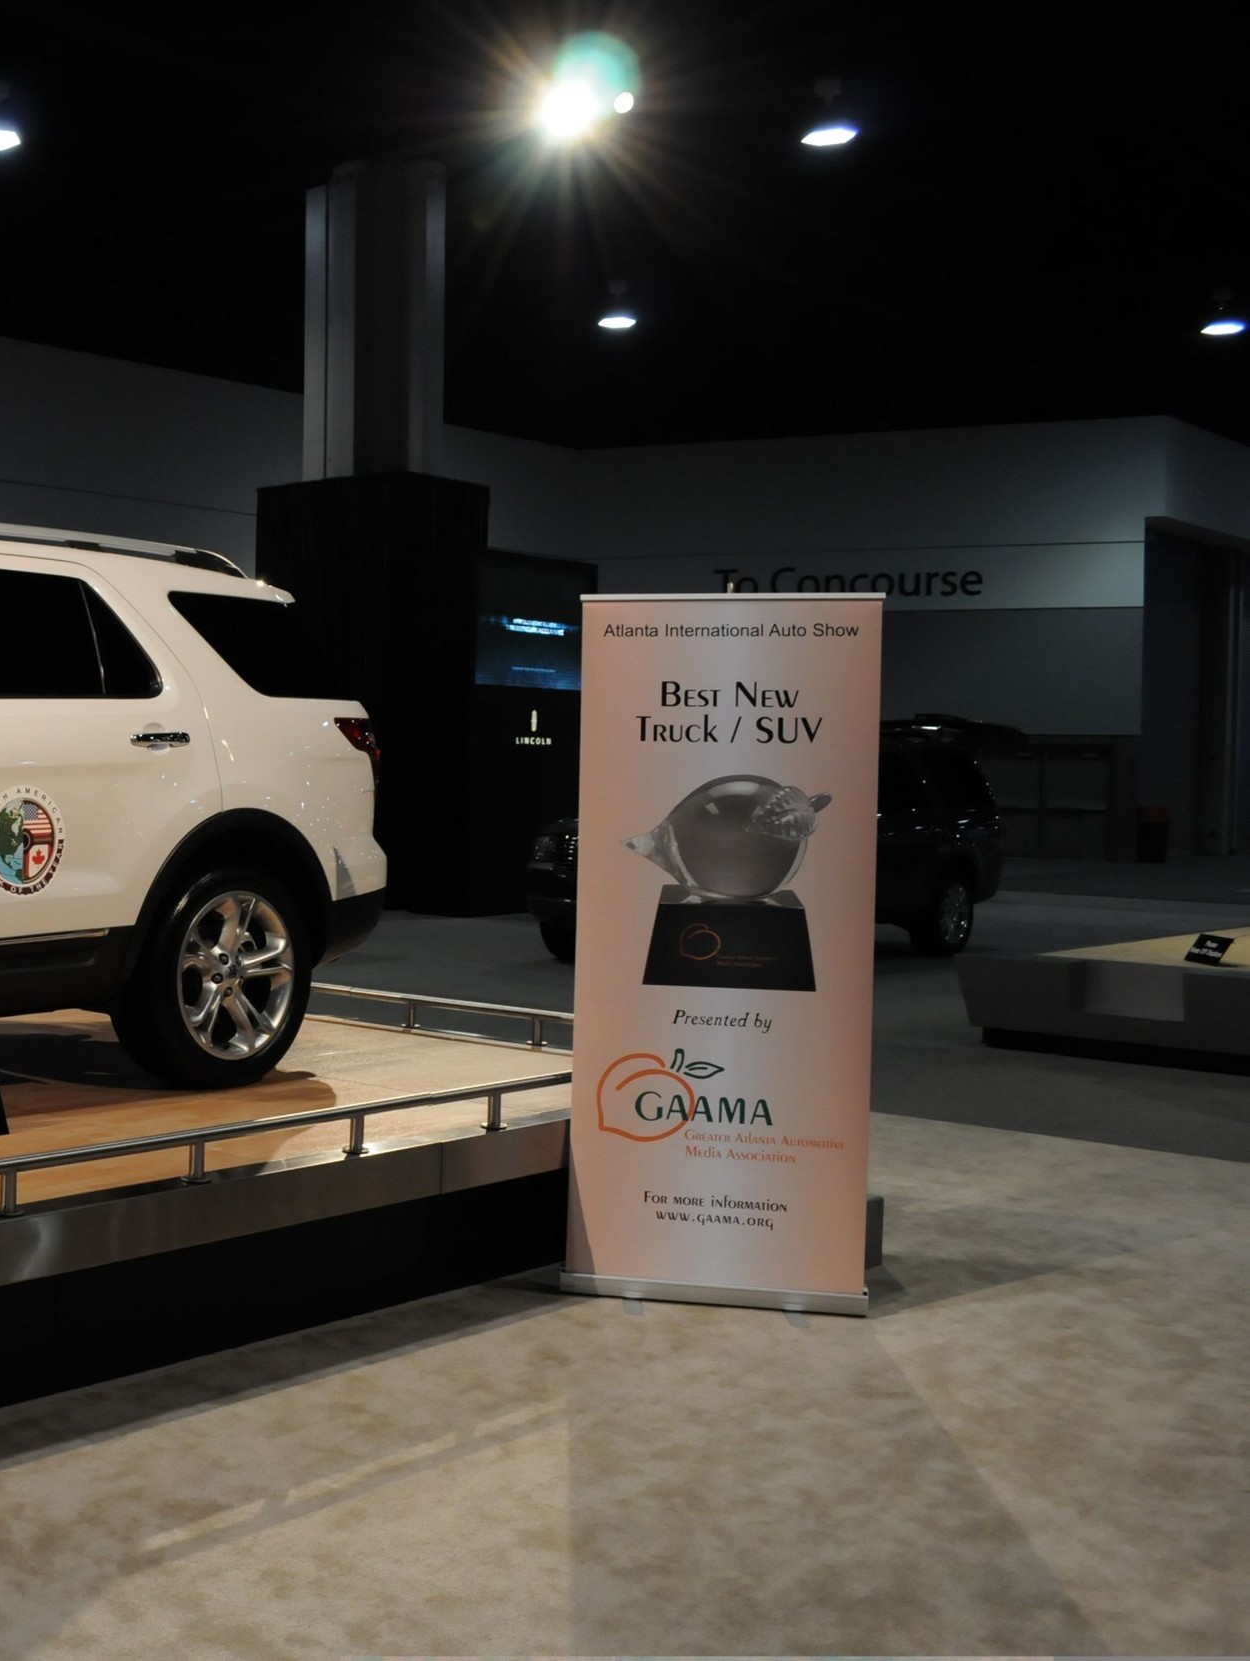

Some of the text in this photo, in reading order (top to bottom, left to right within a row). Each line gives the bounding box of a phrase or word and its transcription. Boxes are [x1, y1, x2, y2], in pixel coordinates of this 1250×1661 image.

[714, 566, 983, 598] To Concourse
[603, 622, 859, 638] Atlanta International Auto Show
[515, 736, 552, 745] LINCOLN
[756, 716, 823, 744] SUV
[16, 787, 64, 834] AMERICAN
[672, 1009, 773, 1034] Presented by
[635, 1090, 773, 1127] GAAMA
